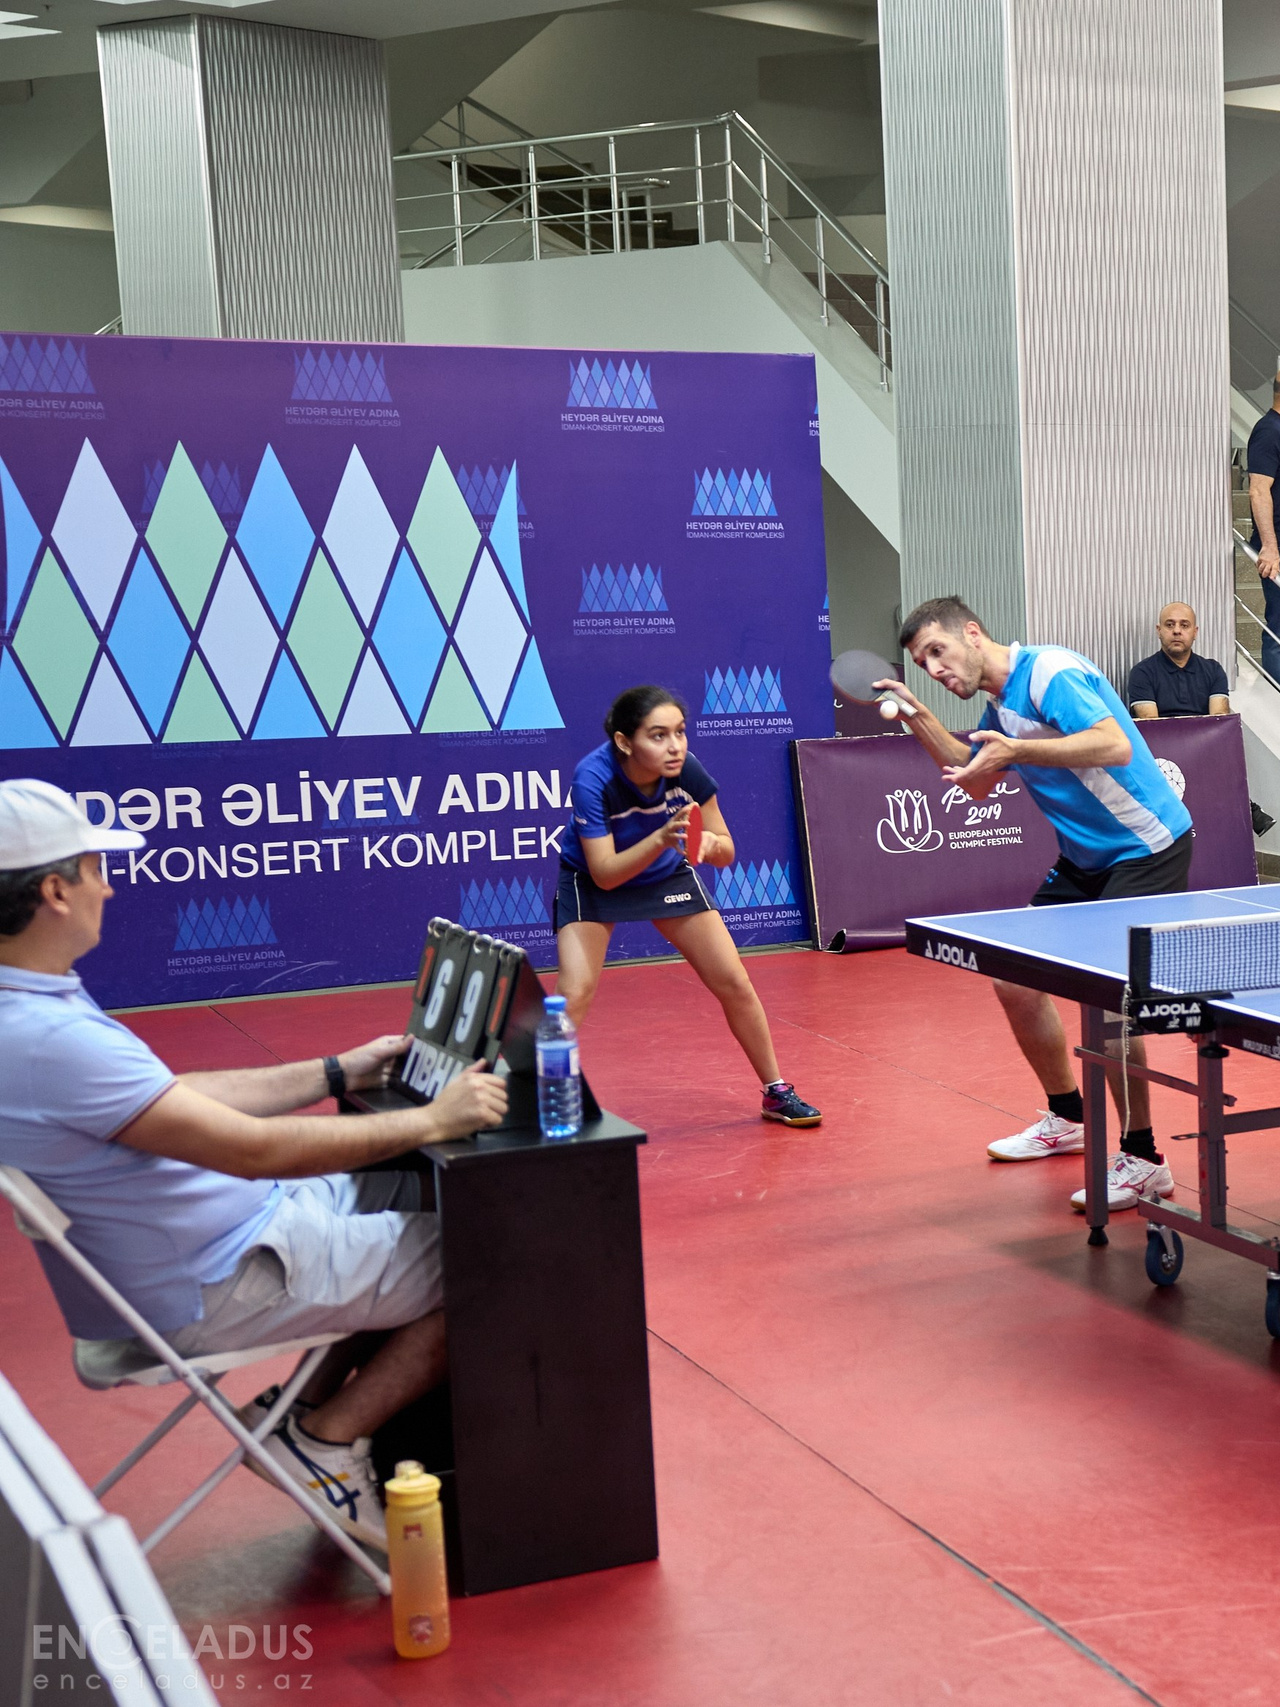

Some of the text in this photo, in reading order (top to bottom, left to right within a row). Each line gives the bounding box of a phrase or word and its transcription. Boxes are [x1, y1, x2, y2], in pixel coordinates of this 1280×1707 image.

[561, 413, 600, 422] HEYDƏR
[636, 415, 664, 424] ADINA
[686, 520, 784, 530] HEYDƏR ƏLİYEV ADINA
[573, 618, 611, 627] HEYDƏR
[647, 617, 675, 626] ADINA
[696, 717, 793, 729] HEYDƏR ƏLİYEV ADINA
[75, 769, 573, 832] DƏR ƏLİYEV ADIN
[964, 803, 1002, 825] 2019
[948, 826, 1022, 840] EUROPEAN YOUTH
[363, 825, 566, 869] KOMPLEK
[950, 836, 1023, 849] OLYMPIC FESTIVAL
[663, 892, 692, 904] GEWO
[743, 911, 774, 921] ƏLİYEV
[775, 910, 802, 918] ADINA
[253, 949, 286, 960] ADINA
[935, 942, 979, 971] JOOLA
[415, 945, 436, 999] 1
[423, 958, 454, 1029] 6
[454, 970, 485, 1043] 9
[1151, 1001, 1202, 1016] JOOLA
